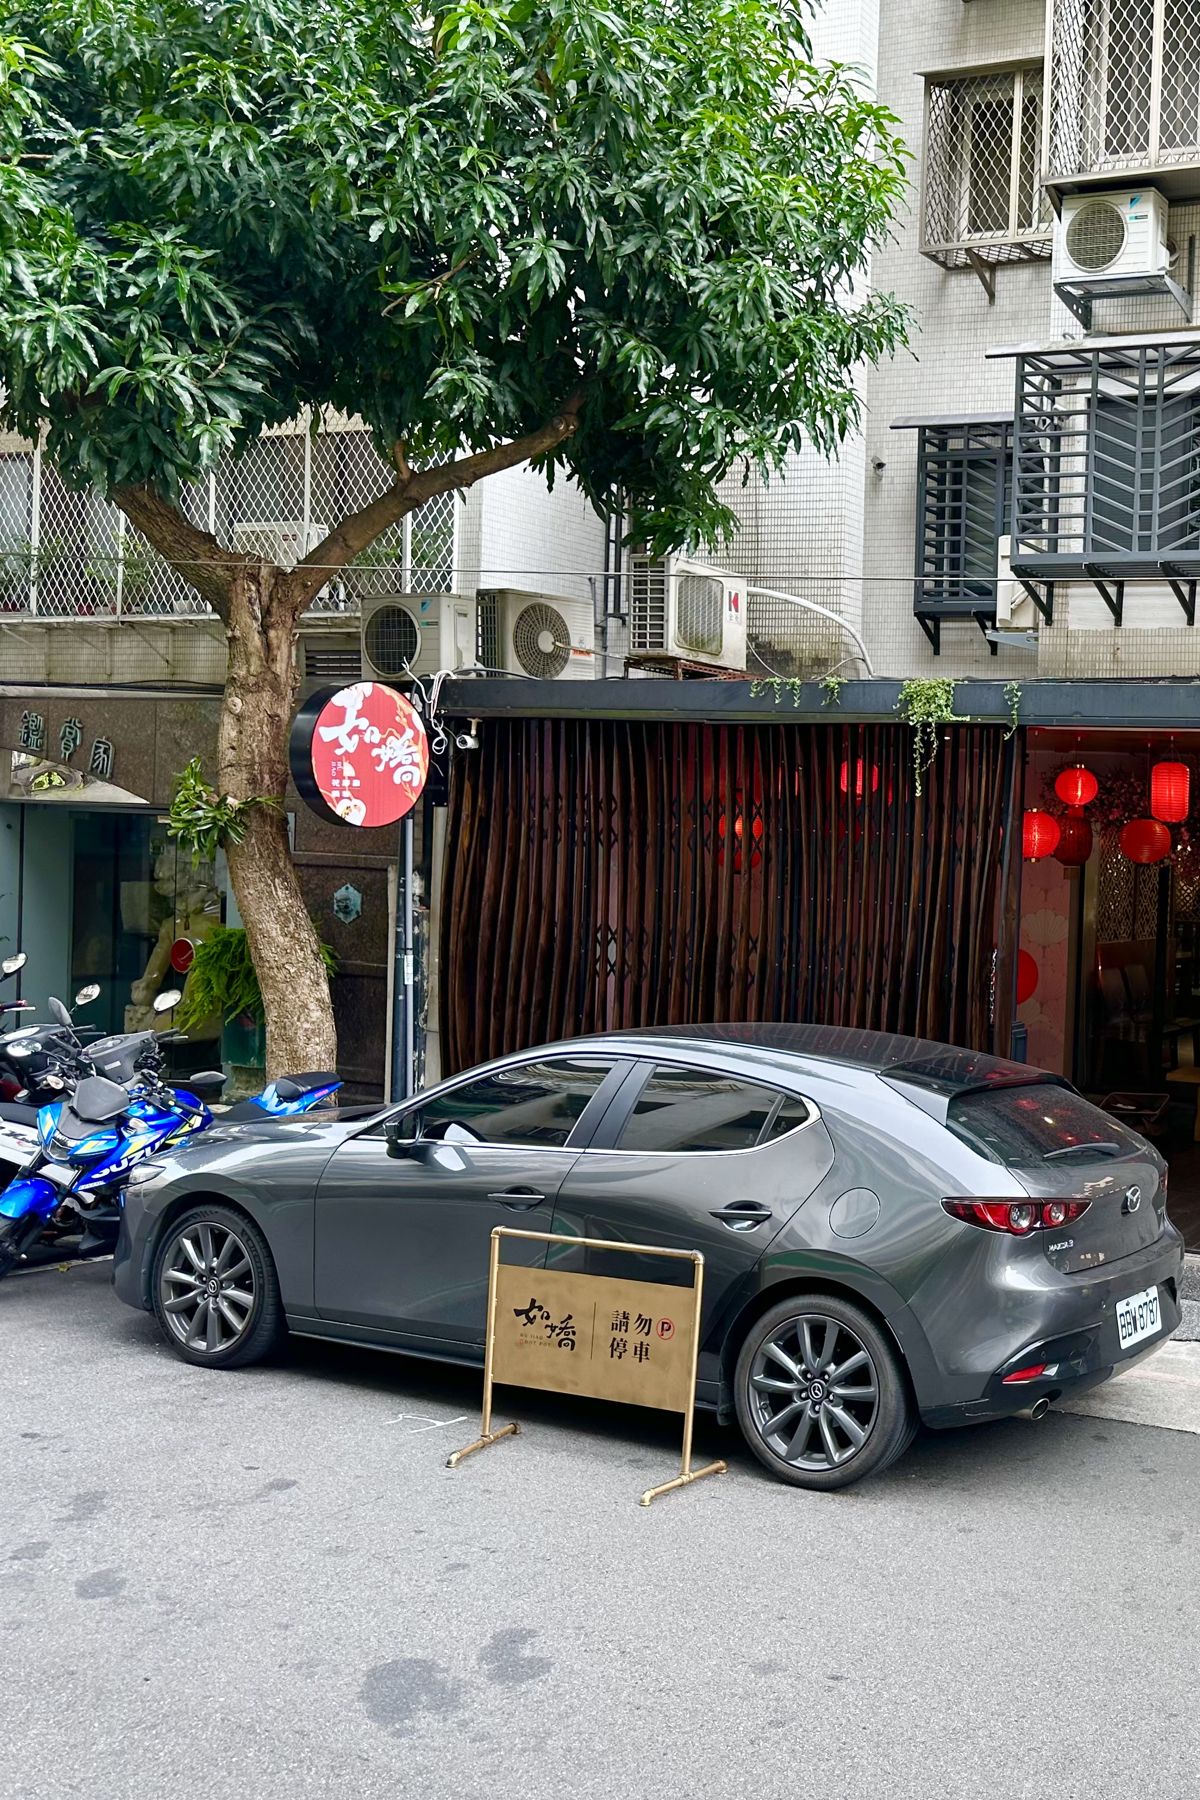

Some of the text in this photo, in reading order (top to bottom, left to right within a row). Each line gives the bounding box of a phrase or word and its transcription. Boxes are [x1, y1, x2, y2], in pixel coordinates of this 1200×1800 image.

[91, 1135, 166, 1179] SUZU
[513, 1298, 577, 1352] 如嬌
[611, 1310, 653, 1337] 請勿
[609, 1337, 651, 1363] 停車
